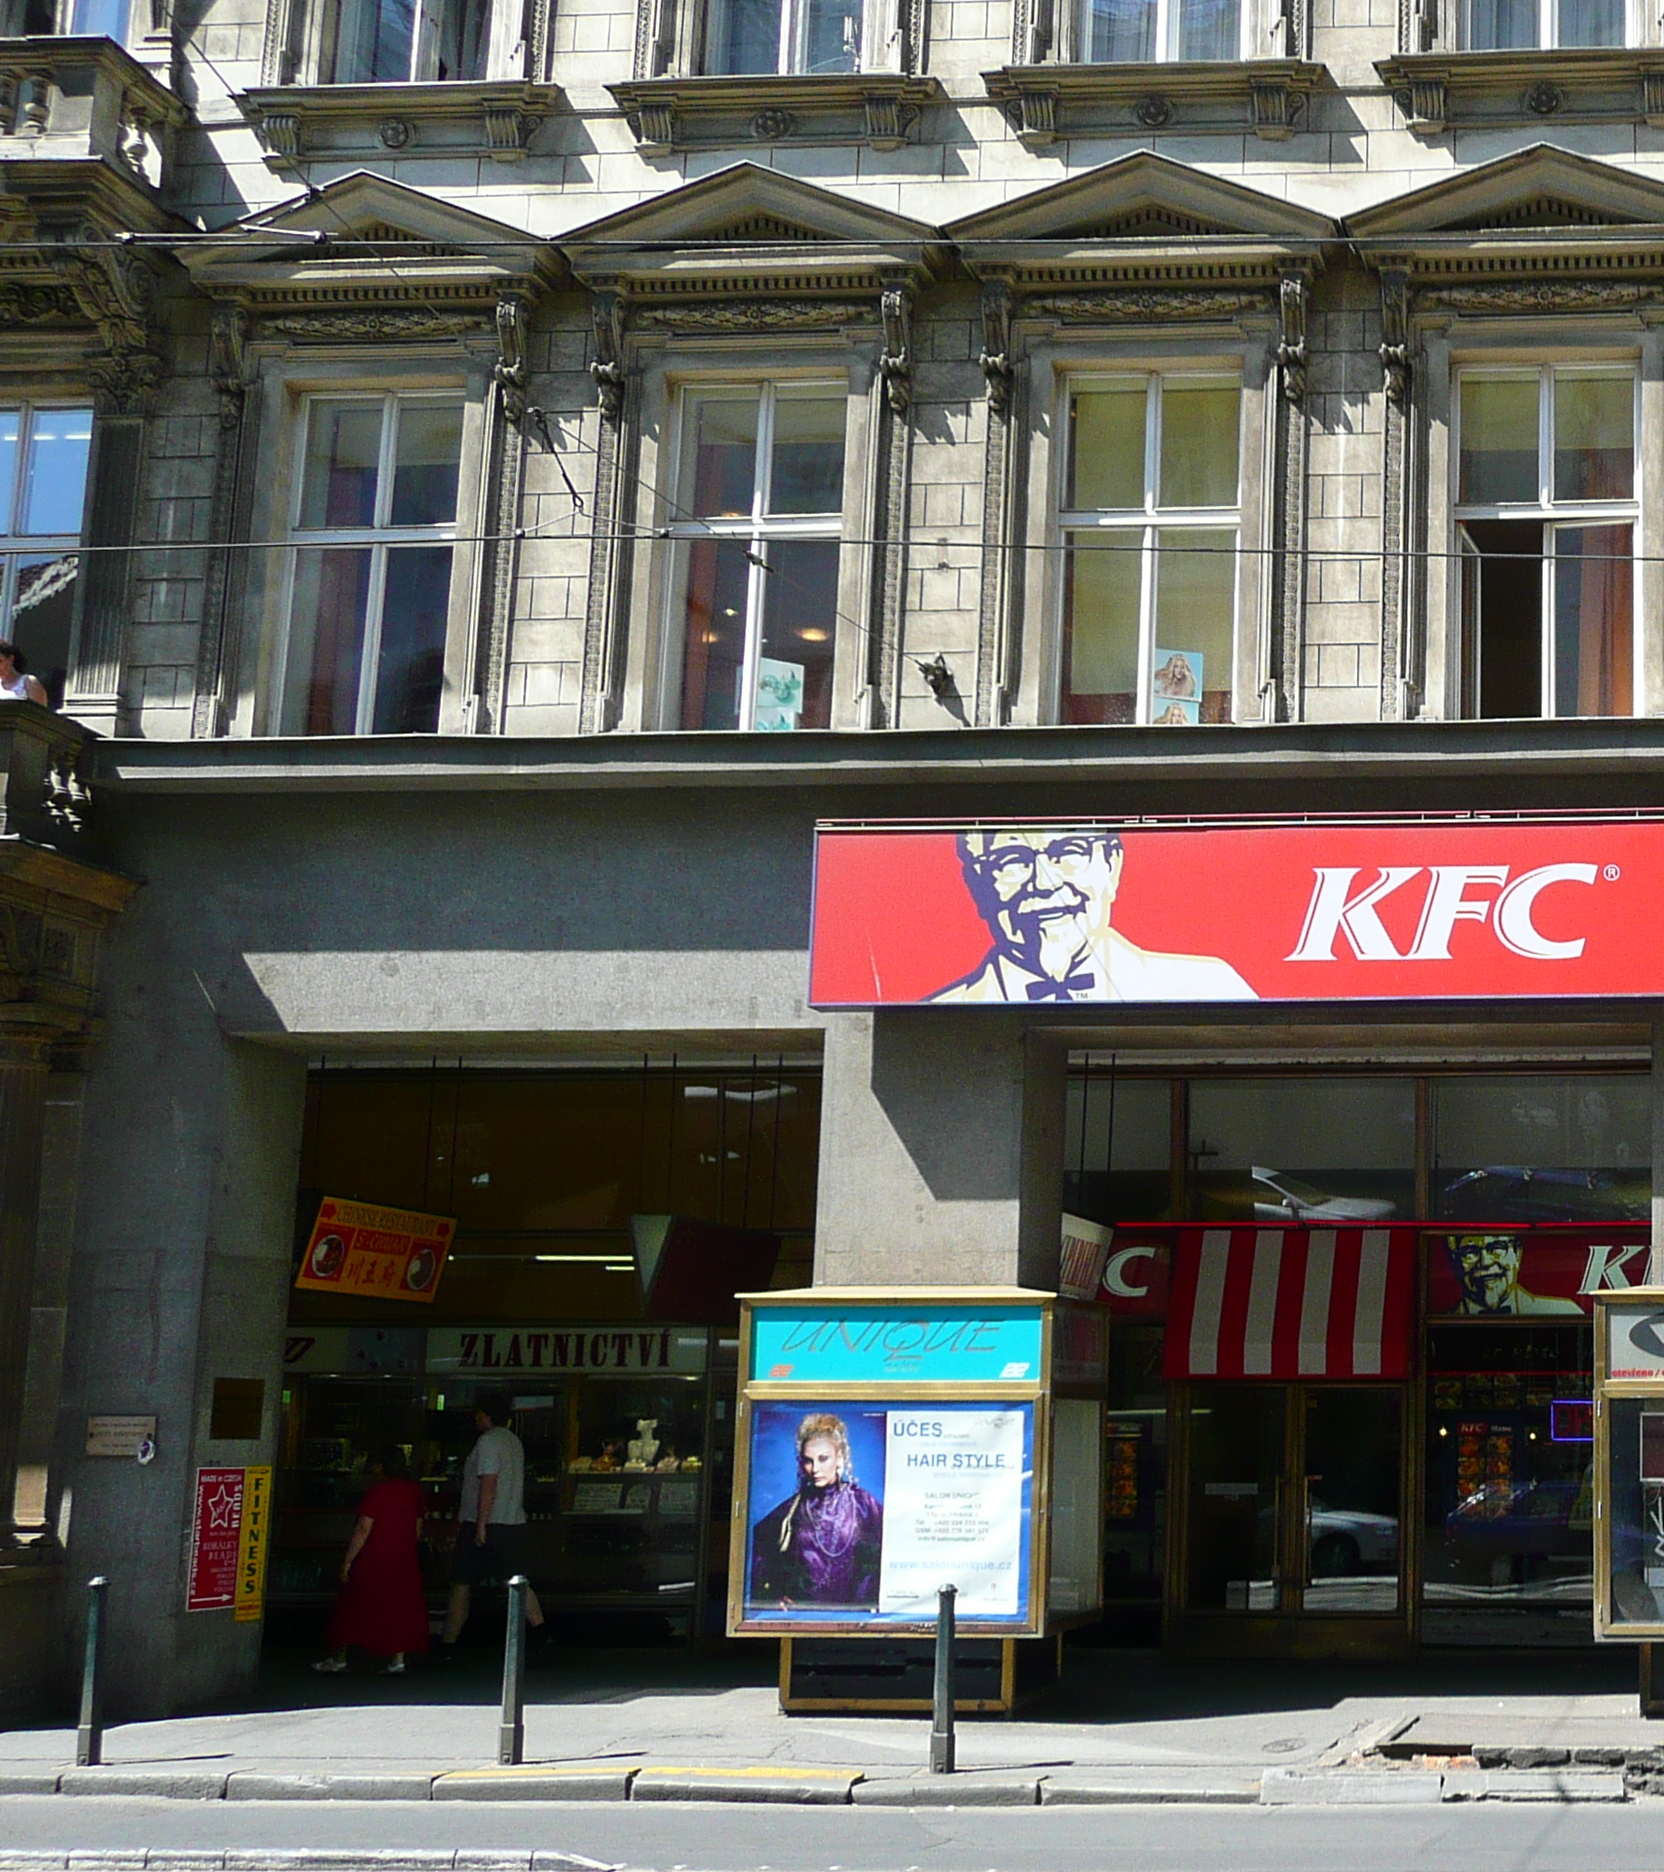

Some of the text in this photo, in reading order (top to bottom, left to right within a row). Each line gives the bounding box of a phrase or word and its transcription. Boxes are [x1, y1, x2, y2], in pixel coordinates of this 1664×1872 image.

[1283, 862, 1599, 961] KFC
[459, 1327, 672, 1368] ZLATNICTVÍ
[781, 1317, 1006, 1362] UNIQUE
[893, 1418, 943, 1438] ÚČES
[906, 1453, 948, 1468] HAIR
[952, 1453, 1006, 1468] STYLE
[243, 1477, 264, 1595] FITNESS
